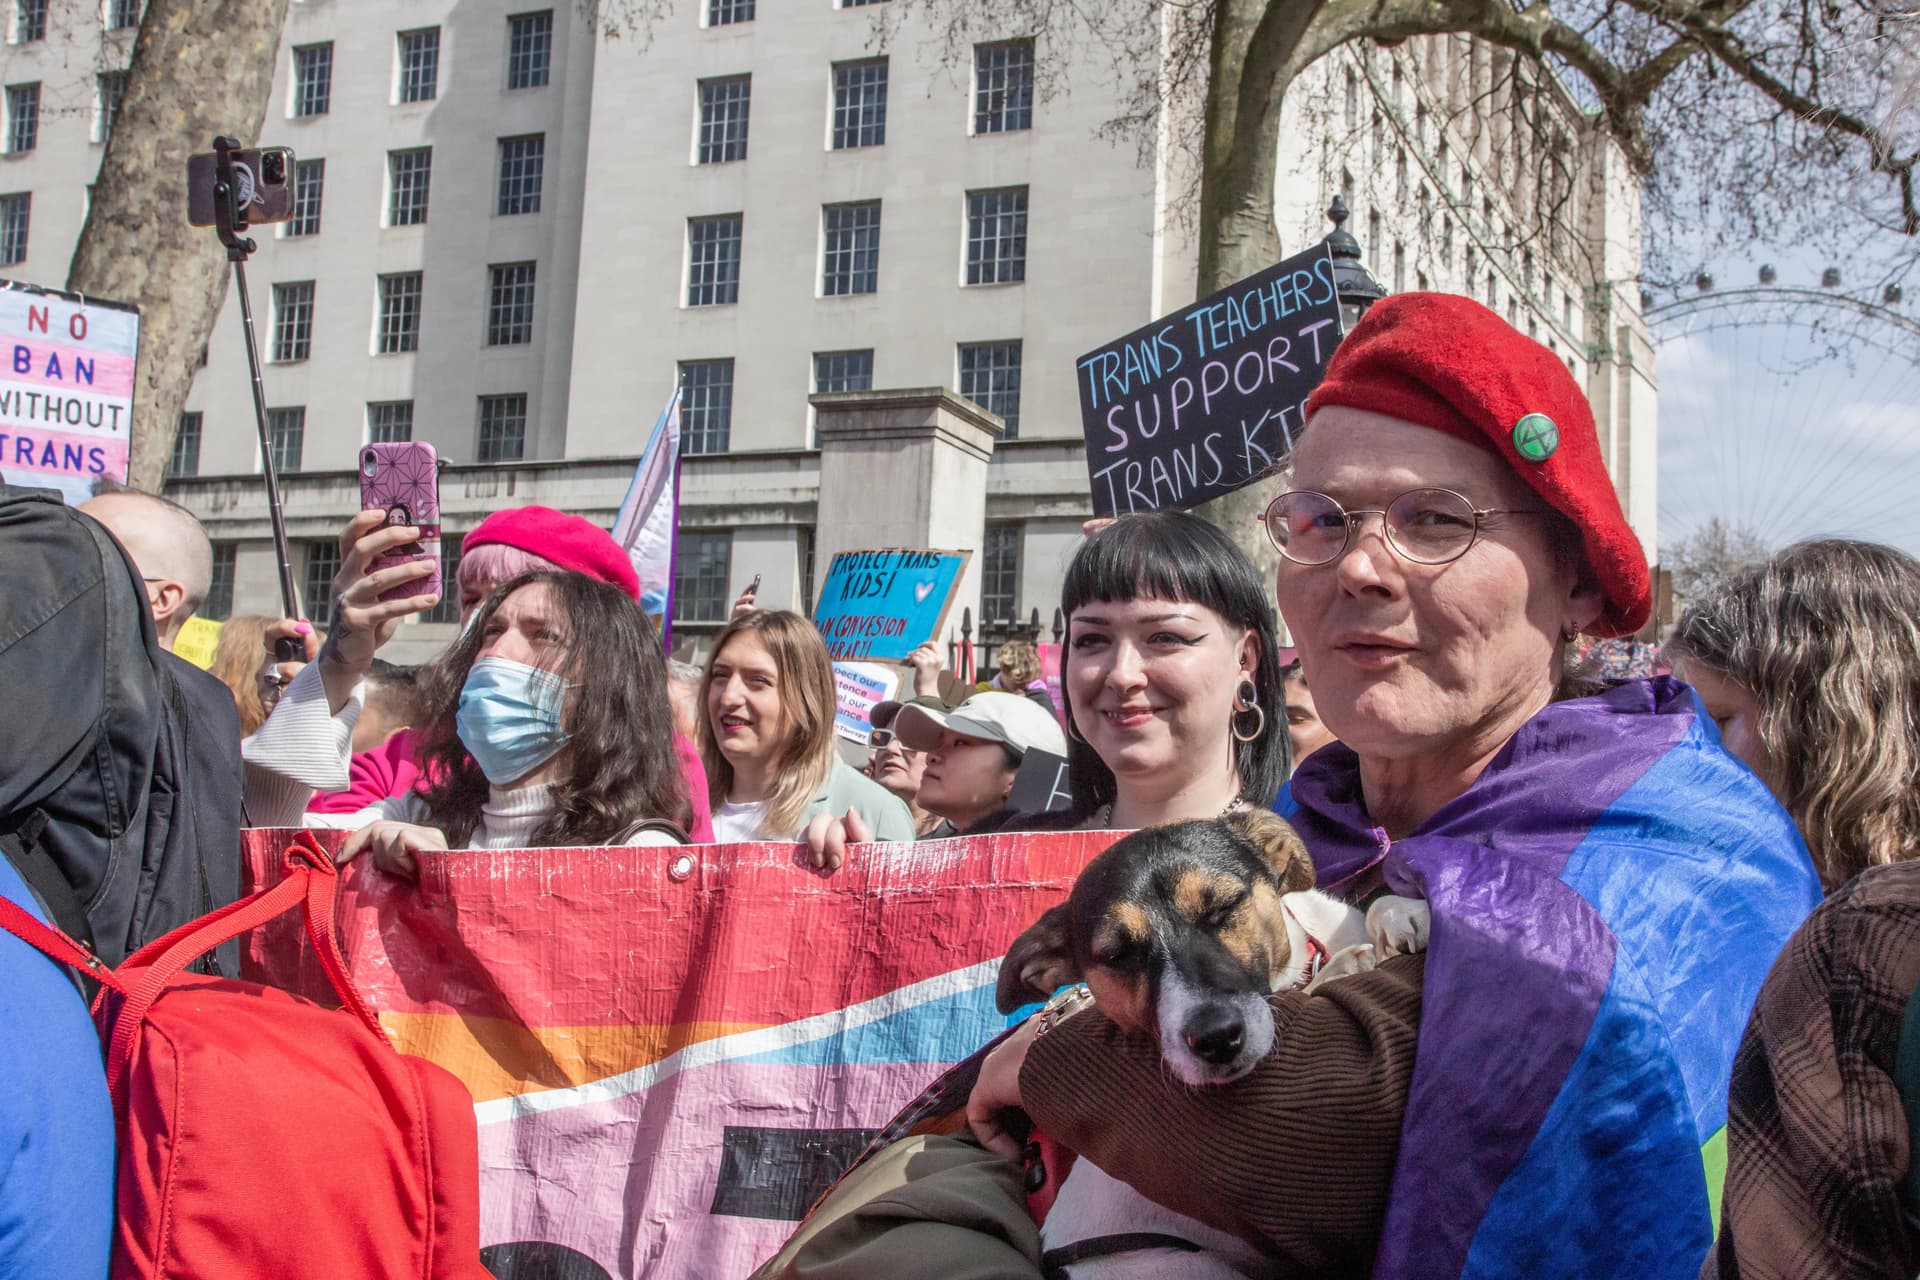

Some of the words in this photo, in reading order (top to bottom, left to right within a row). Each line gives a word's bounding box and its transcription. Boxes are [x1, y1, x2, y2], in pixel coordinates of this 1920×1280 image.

[28, 304, 88, 341] NO
[1078, 325, 1182, 409] TRANS
[1185, 257, 1334, 358] TEACHERS
[13, 345, 95, 385] BAN
[1105, 318, 1334, 452] SUPPORT
[0, 389, 124, 431] WITHOUT
[0, 433, 106, 475] TRANS
[1092, 432, 1223, 518] TRANS
[1241, 397, 1310, 475] KI
[832, 550, 893, 577] PROTECT
[896, 550, 943, 569] TRANS
[840, 570, 897, 601] KIDS!
[834, 666, 858, 680] pect
[859, 676, 879, 689] our
[838, 680, 868, 698] tence
[837, 707, 863, 721] ance
[848, 698, 867, 710] our
